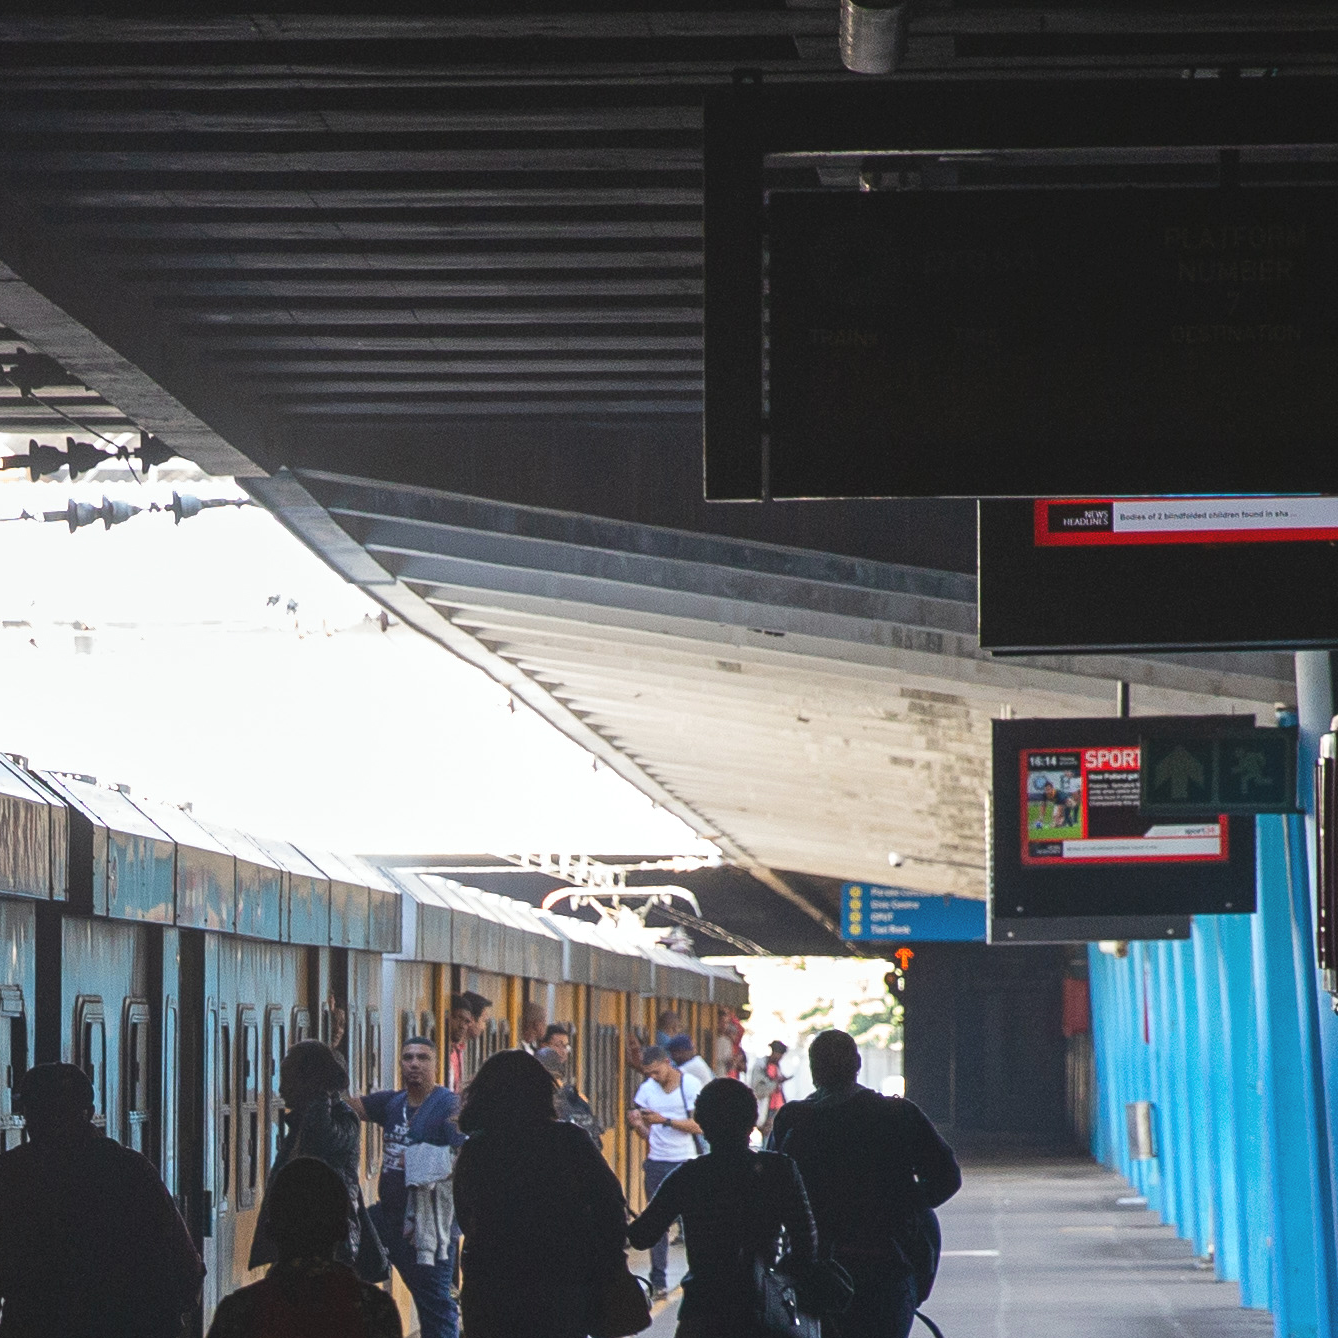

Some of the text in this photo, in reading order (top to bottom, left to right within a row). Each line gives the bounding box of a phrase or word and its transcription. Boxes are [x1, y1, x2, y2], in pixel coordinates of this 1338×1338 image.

[1163, 223, 1307, 250] PLATFORM
[1177, 258, 1294, 284] NUMBER
[1170, 323, 1303, 344] DESTINATION
[1063, 517, 1109, 527] HEADLINES
[1084, 509, 1109, 519] NEWS
[1119, 512, 1147, 521] Bodies
[1208, 510, 1241, 519] children
[1241, 510, 1265, 518] found
